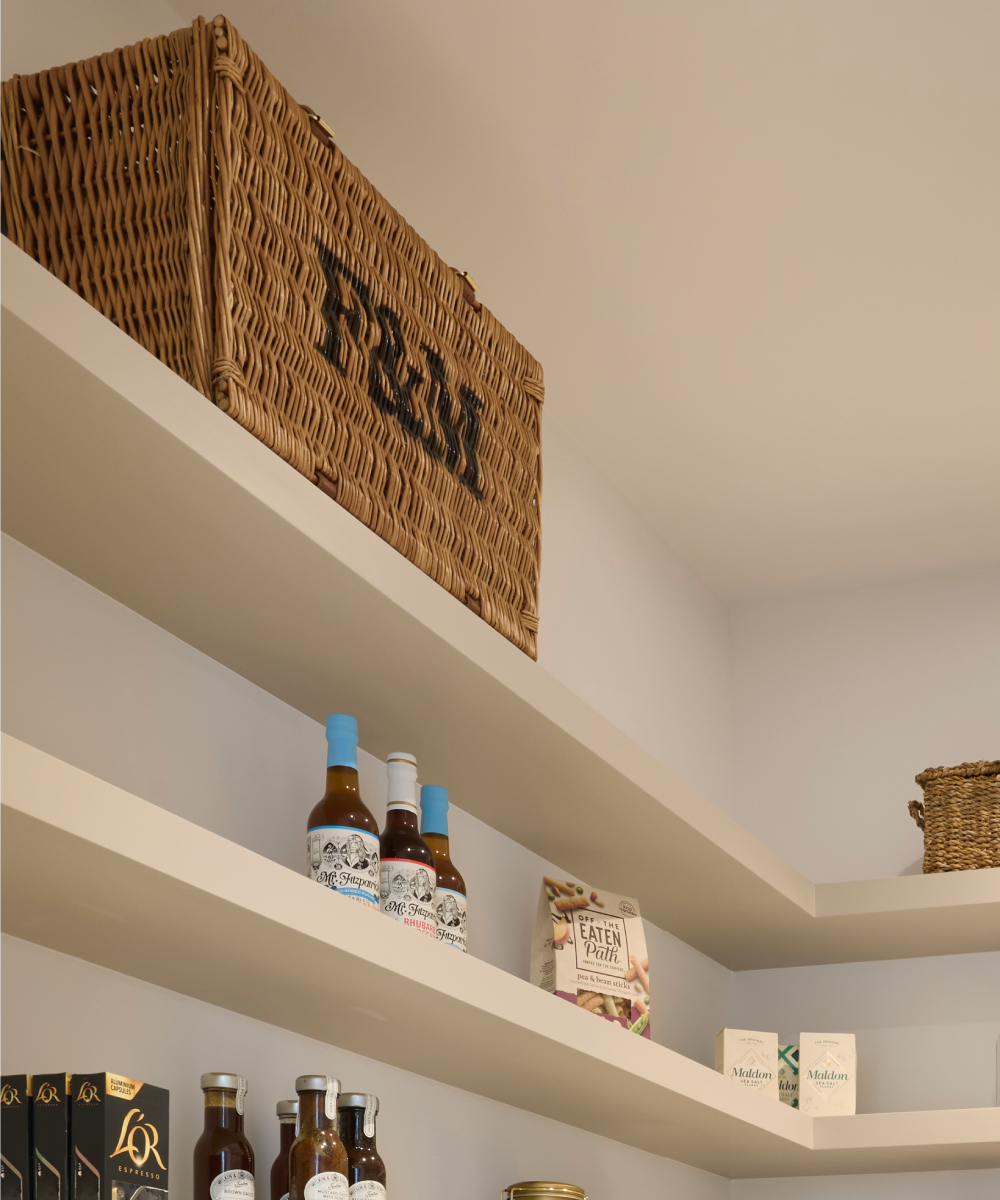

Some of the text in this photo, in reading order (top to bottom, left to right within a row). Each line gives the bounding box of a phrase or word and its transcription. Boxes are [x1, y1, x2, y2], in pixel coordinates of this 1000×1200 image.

[313, 236, 483, 500] F&M
[316, 871, 338, 886] Mr.
[578, 914, 619, 930] OFF THE
[580, 923, 621, 948] EATEN
[584, 941, 620, 964] Path
[577, 973, 588, 981] pea
[596, 977, 611, 986] bean
[613, 981, 631, 990] sticks
[731, 1067, 773, 1080] Maldon
[806, 1069, 848, 1081] Maldon
[110, 1077, 136, 1090] ALUMINIUM
[110, 1084, 132, 1096] CAPSULES
[118, 1165, 160, 1180] ESPRESSO
[224, 1188, 242, 1196] BROWN
